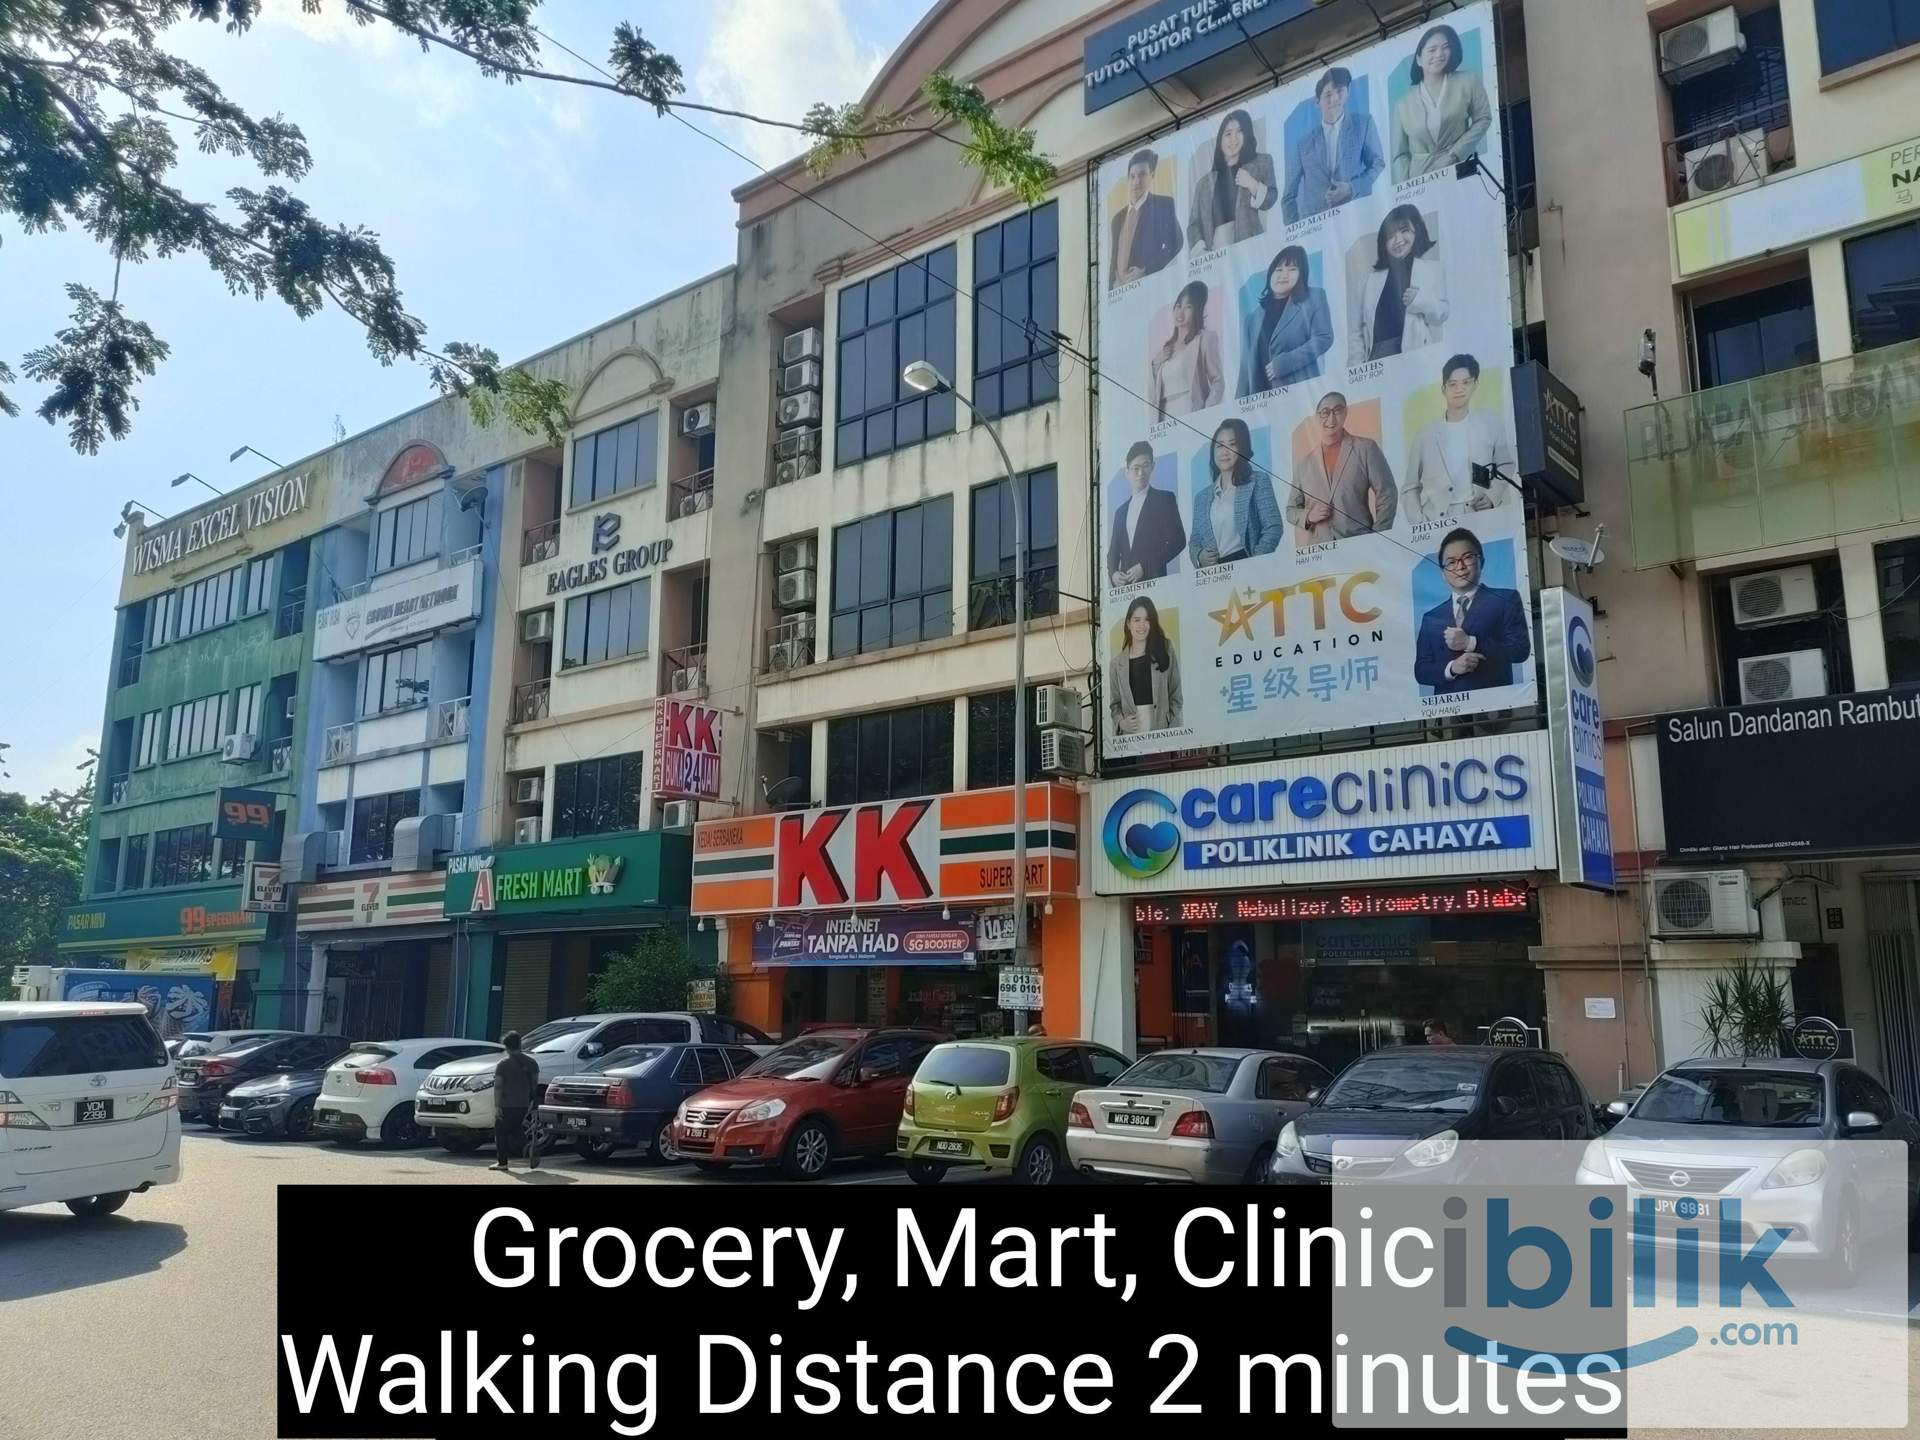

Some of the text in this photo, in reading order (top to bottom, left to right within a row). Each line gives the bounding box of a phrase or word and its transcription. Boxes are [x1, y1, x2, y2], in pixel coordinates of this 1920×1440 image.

[1127, 13, 1178, 51] PUSAT
[1138, 27, 1193, 63] TUTOR
[1348, 360, 1384, 377] MATHS
[132, 472, 310, 576] WISMA EXCEL VISION
[1411, 517, 1458, 534] PHYSICS
[1295, 541, 1338, 557] SCIENCE
[1410, 533, 1431, 543] JUNG
[546, 538, 673, 595] EAGLES GROUP
[1195, 562, 1235, 579] ENGLISH
[1109, 579, 1158, 598] CHEMISTRY
[1207, 570, 1384, 648] ATTC
[1215, 629, 1384, 668] EDUCATION
[1226, 655, 1380, 714] 星级导师
[1421, 692, 1470, 706] SEJARAH
[1571, 688, 1599, 729] care
[670, 702, 719, 754] KK
[1668, 717, 1723, 743] Salun
[1729, 707, 1832, 737] Dandanan
[684, 751, 701, 793] 24
[701, 755, 720, 793] JAM
[1181, 755, 1529, 829] careclinics
[223, 802, 269, 828] 99
[778, 799, 935, 907] KK
[1200, 821, 1502, 865] POLIKLINIK CAHAYA
[448, 855, 468, 875] PASAR
[980, 863, 1045, 889] SUPERART
[470, 867, 582, 912] A FRESH MART
[180, 906, 206, 934] 99
[361, 903, 380, 912] ELEVEN
[826, 918, 881, 934] INTERNET
[807, 932, 899, 954] TANPA HAD
[908, 939, 962, 951] 5G BOOSTER
[1000, 984, 1041, 994] 696 0101
[1013, 975, 1030, 984] 013
[1492, 1032, 1524, 1043] ATTC
[1797, 1033, 1835, 1046] ATTC
[1114, 1113, 1150, 1126] WKR 3804
